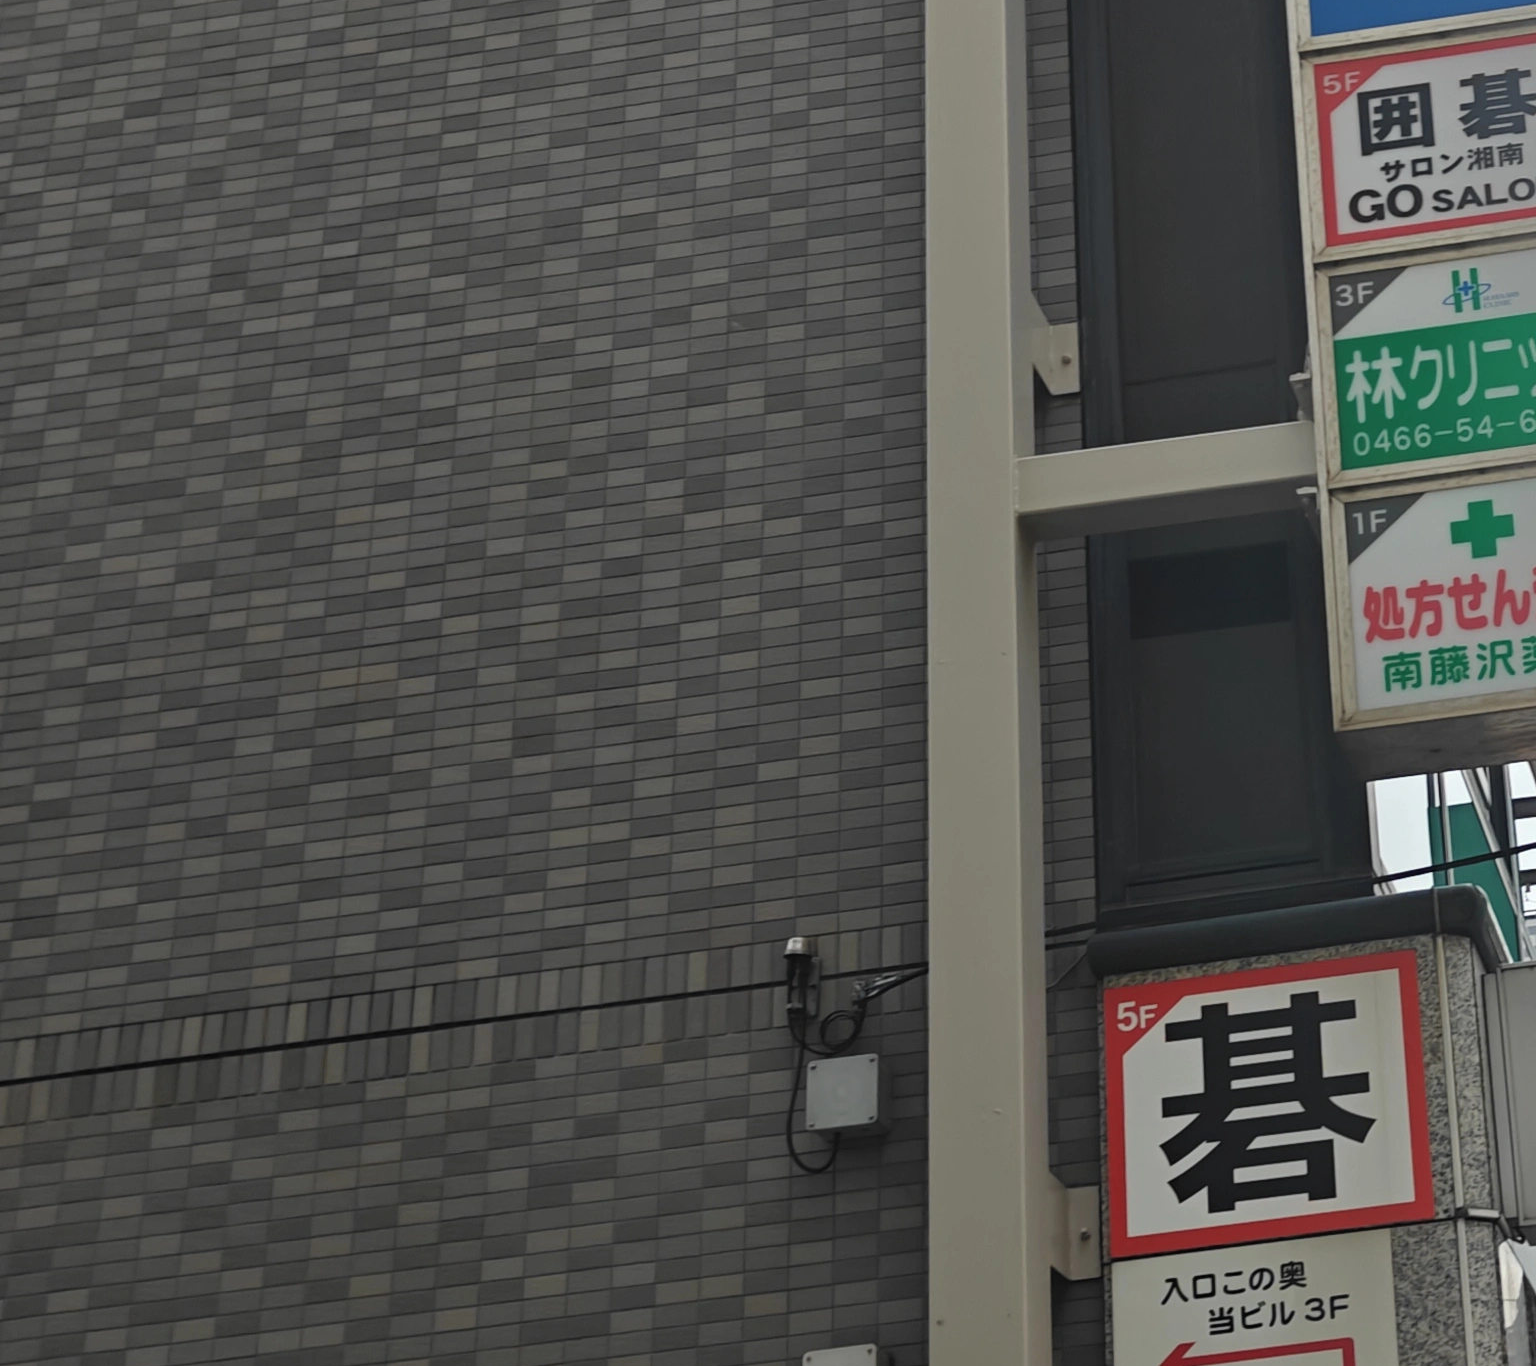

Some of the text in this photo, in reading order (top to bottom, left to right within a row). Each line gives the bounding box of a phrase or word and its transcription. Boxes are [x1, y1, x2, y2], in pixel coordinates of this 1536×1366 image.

[1322, 70, 1361, 95] 5F
[1380, 142, 1525, 183] サロン湘南
[1349, 184, 1424, 223] GO
[1335, 281, 1374, 307] 3F
[1352, 509, 1388, 537] 1F
[1117, 1001, 1158, 1032] 5F
[1159, 991, 1377, 1214] 碁
[1160, 1261, 1308, 1306] 入口この奥
